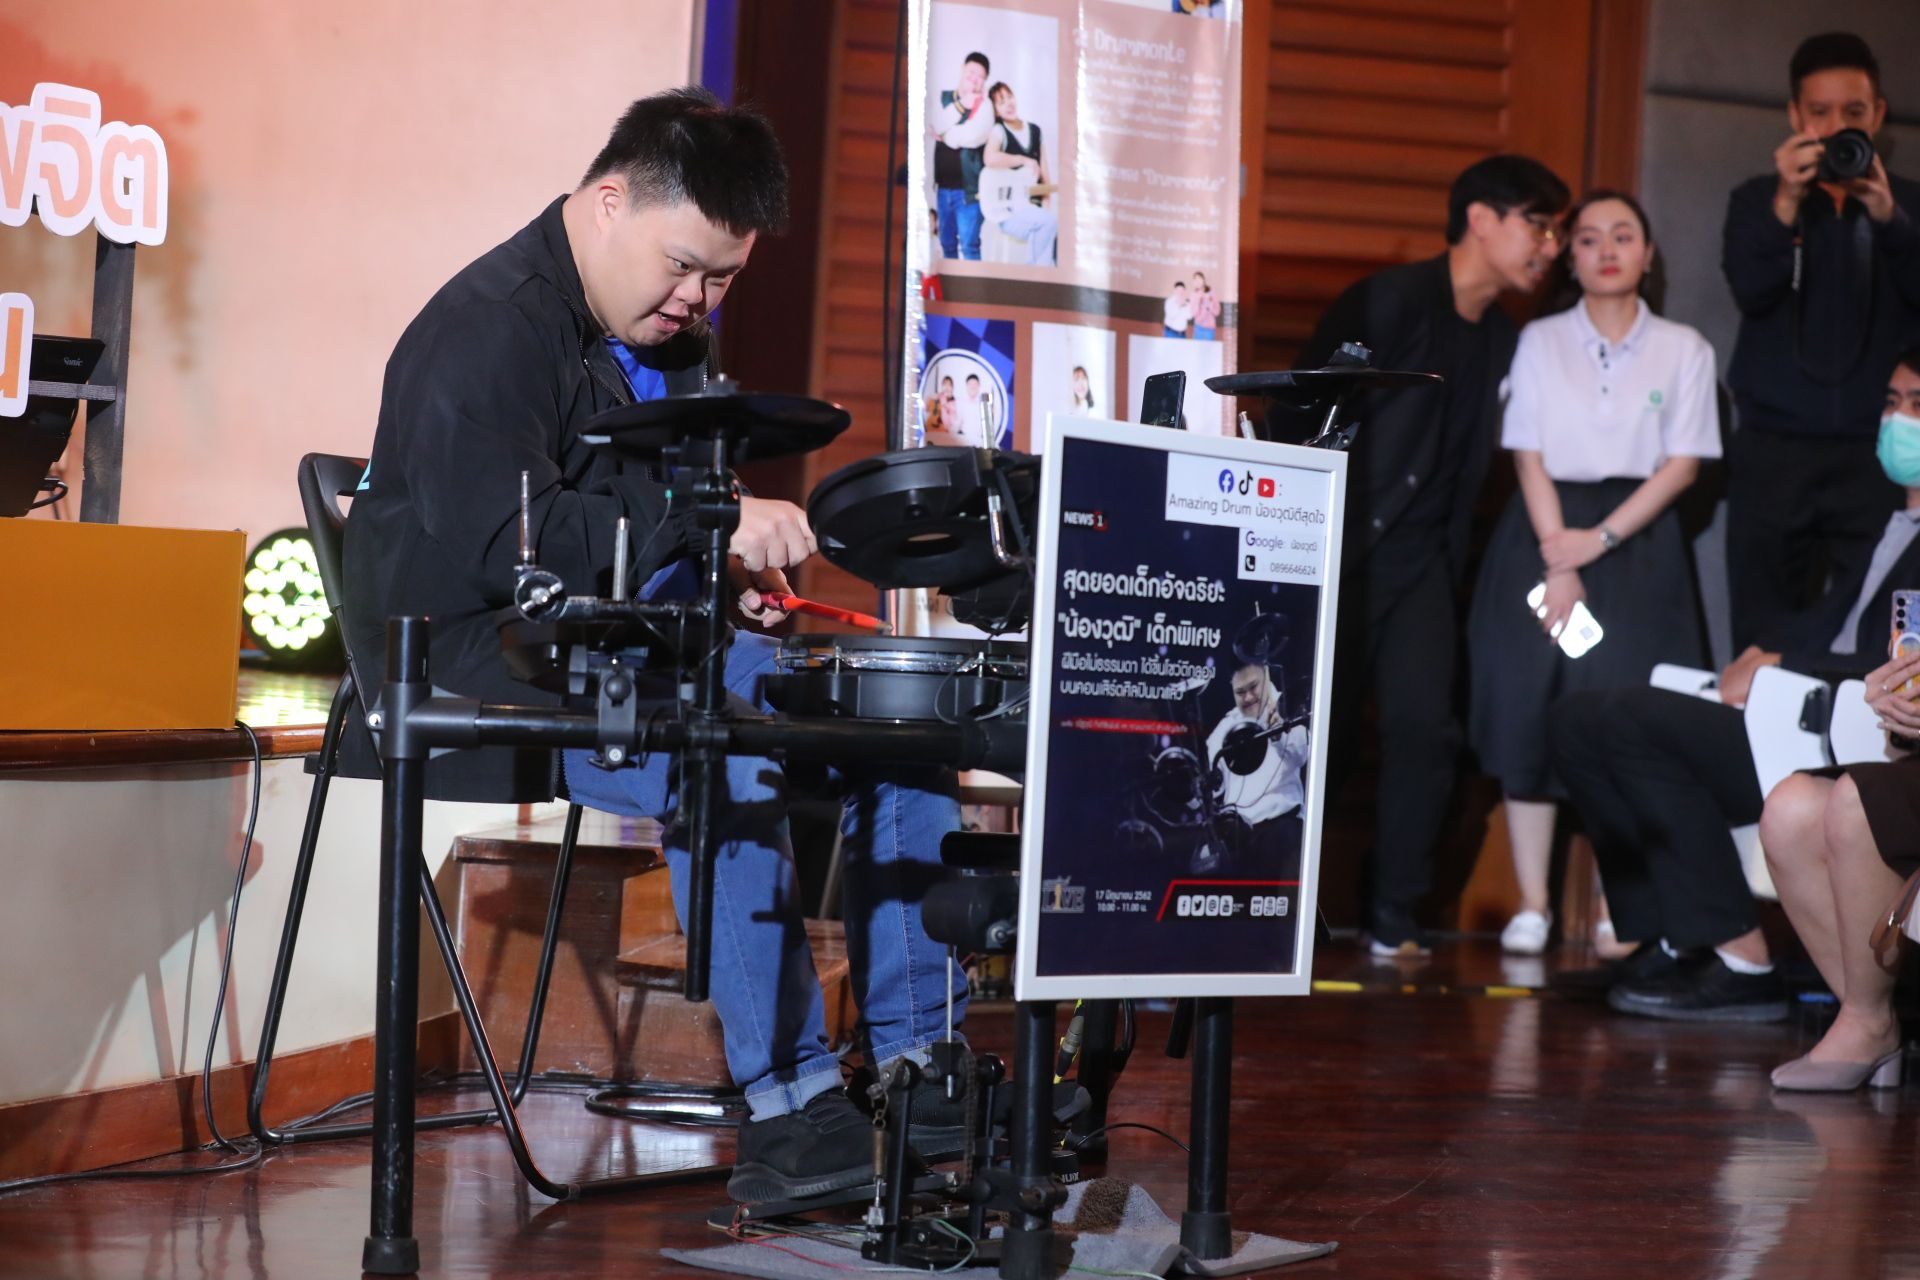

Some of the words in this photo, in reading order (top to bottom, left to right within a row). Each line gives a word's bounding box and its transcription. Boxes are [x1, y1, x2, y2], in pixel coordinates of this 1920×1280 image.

[1168, 493, 1218, 515] Amazing
[1222, 499, 1251, 515] Drum
[1064, 511, 1094, 526] NEWS
[1245, 531, 1284, 551] Google
[1063, 564, 1226, 603] สุดยอดเด็กอัจฉริยะ
[1146, 612, 1221, 648] เด็กพิเศษ
